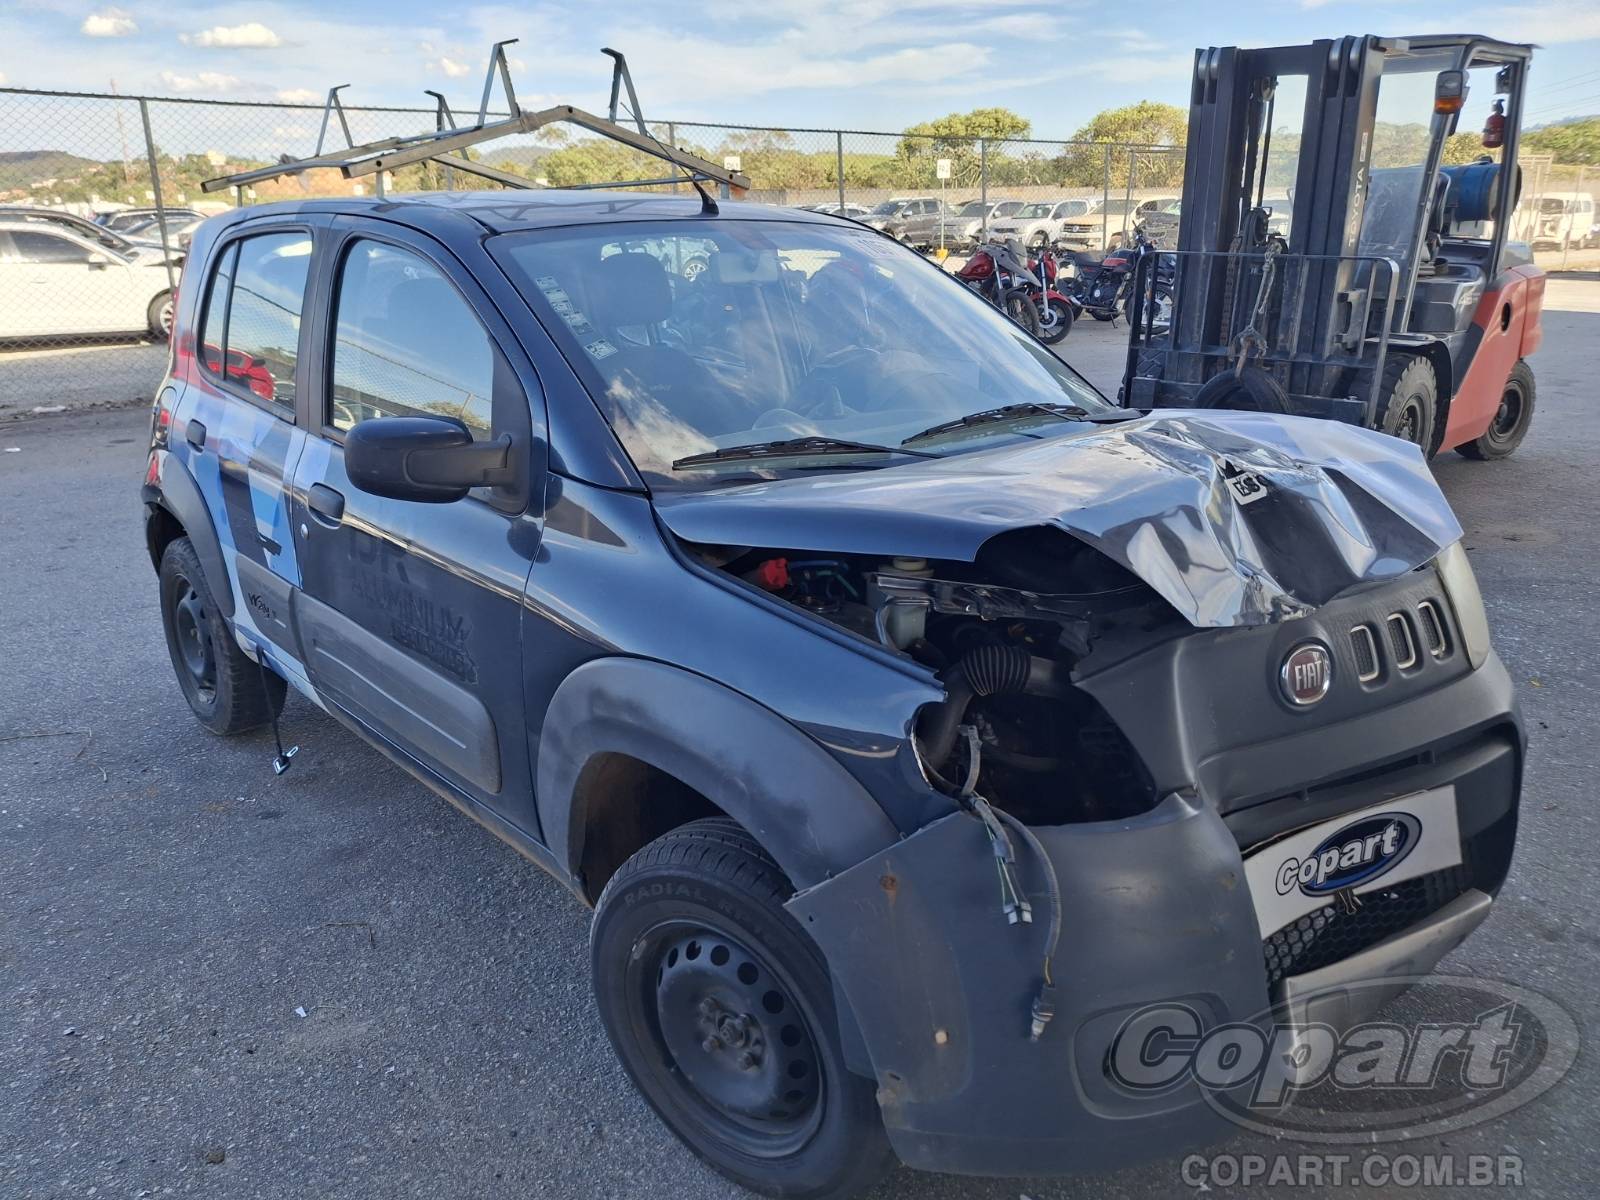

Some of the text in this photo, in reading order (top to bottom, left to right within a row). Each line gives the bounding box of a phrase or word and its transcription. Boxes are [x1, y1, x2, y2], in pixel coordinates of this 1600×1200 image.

[1348, 167, 1365, 247] TOYOTA
[1294, 660, 1323, 691] FIAT
[1275, 820, 1400, 896] Copart
[623, 882, 709, 907] RADIAL
